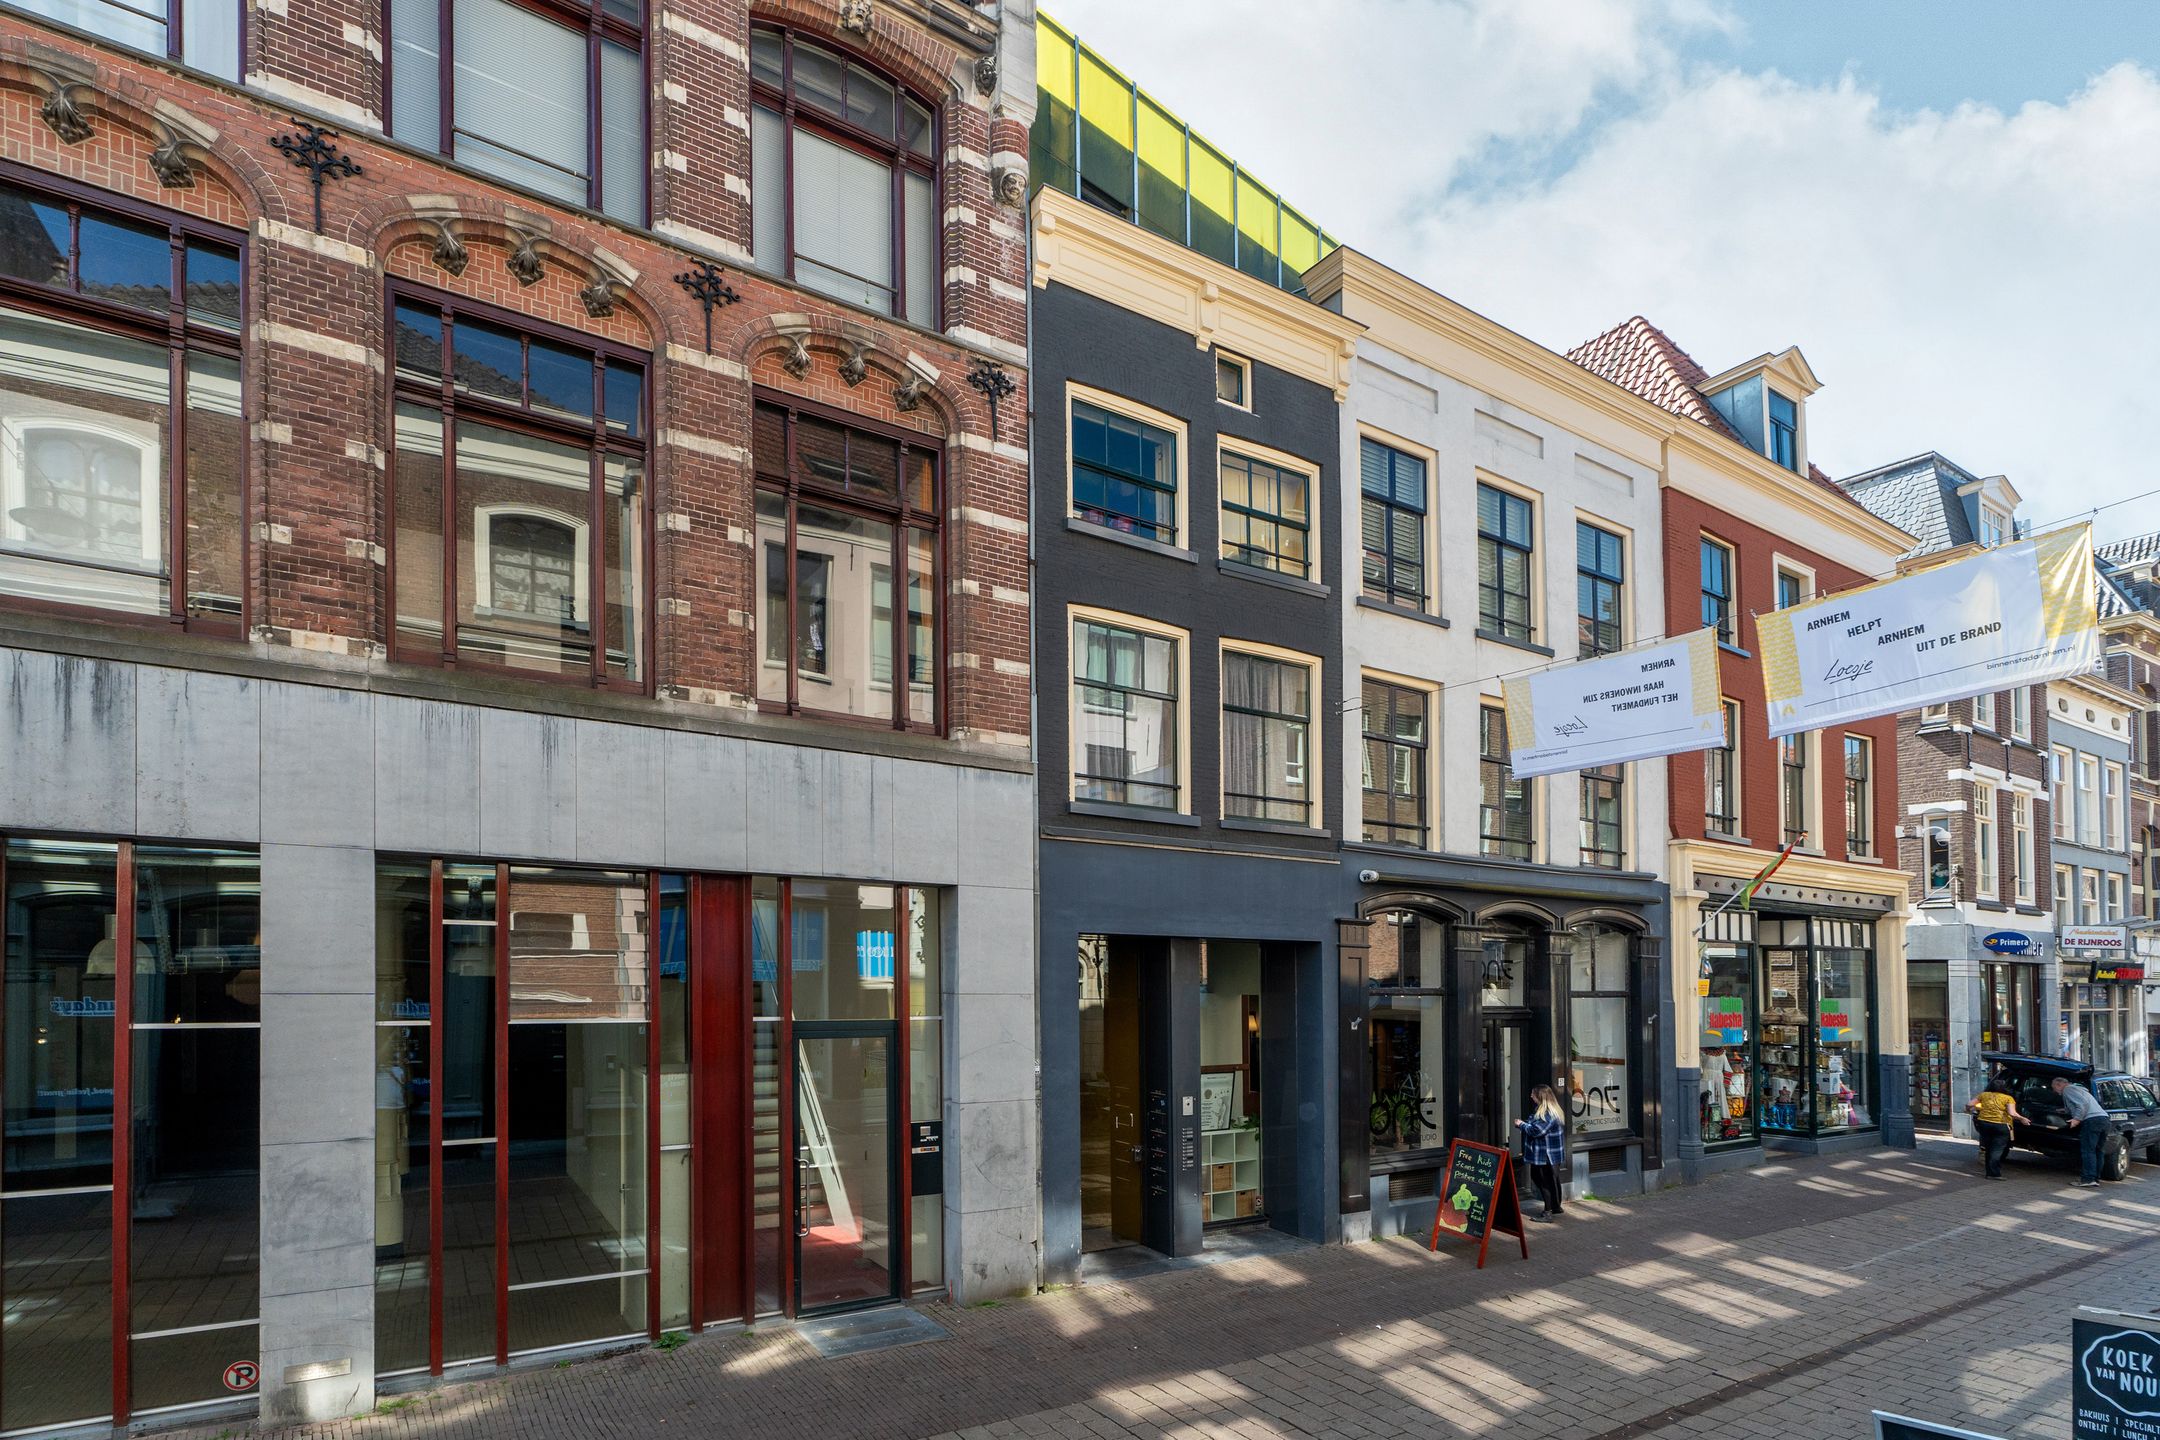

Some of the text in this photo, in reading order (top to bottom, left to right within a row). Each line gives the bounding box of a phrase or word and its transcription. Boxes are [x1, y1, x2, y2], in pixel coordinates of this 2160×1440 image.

[1807, 610, 1851, 631] ARNHEM
[1847, 618, 1882, 637] HELPT
[1877, 624, 1925, 646] ARNHEM
[1916, 621, 2002, 652] UIT DE BRAND
[1986, 644, 2077, 670] binnenstadarnhem.nl
[2000, 938, 2029, 946] Primera
[2064, 938, 2122, 947] DE RIJNROOS
[2102, 1346, 2154, 1374] KOEK
[2096, 1366, 2160, 1397] VAN NOU
[2079, 1408, 2110, 1423] BAKHUIS
